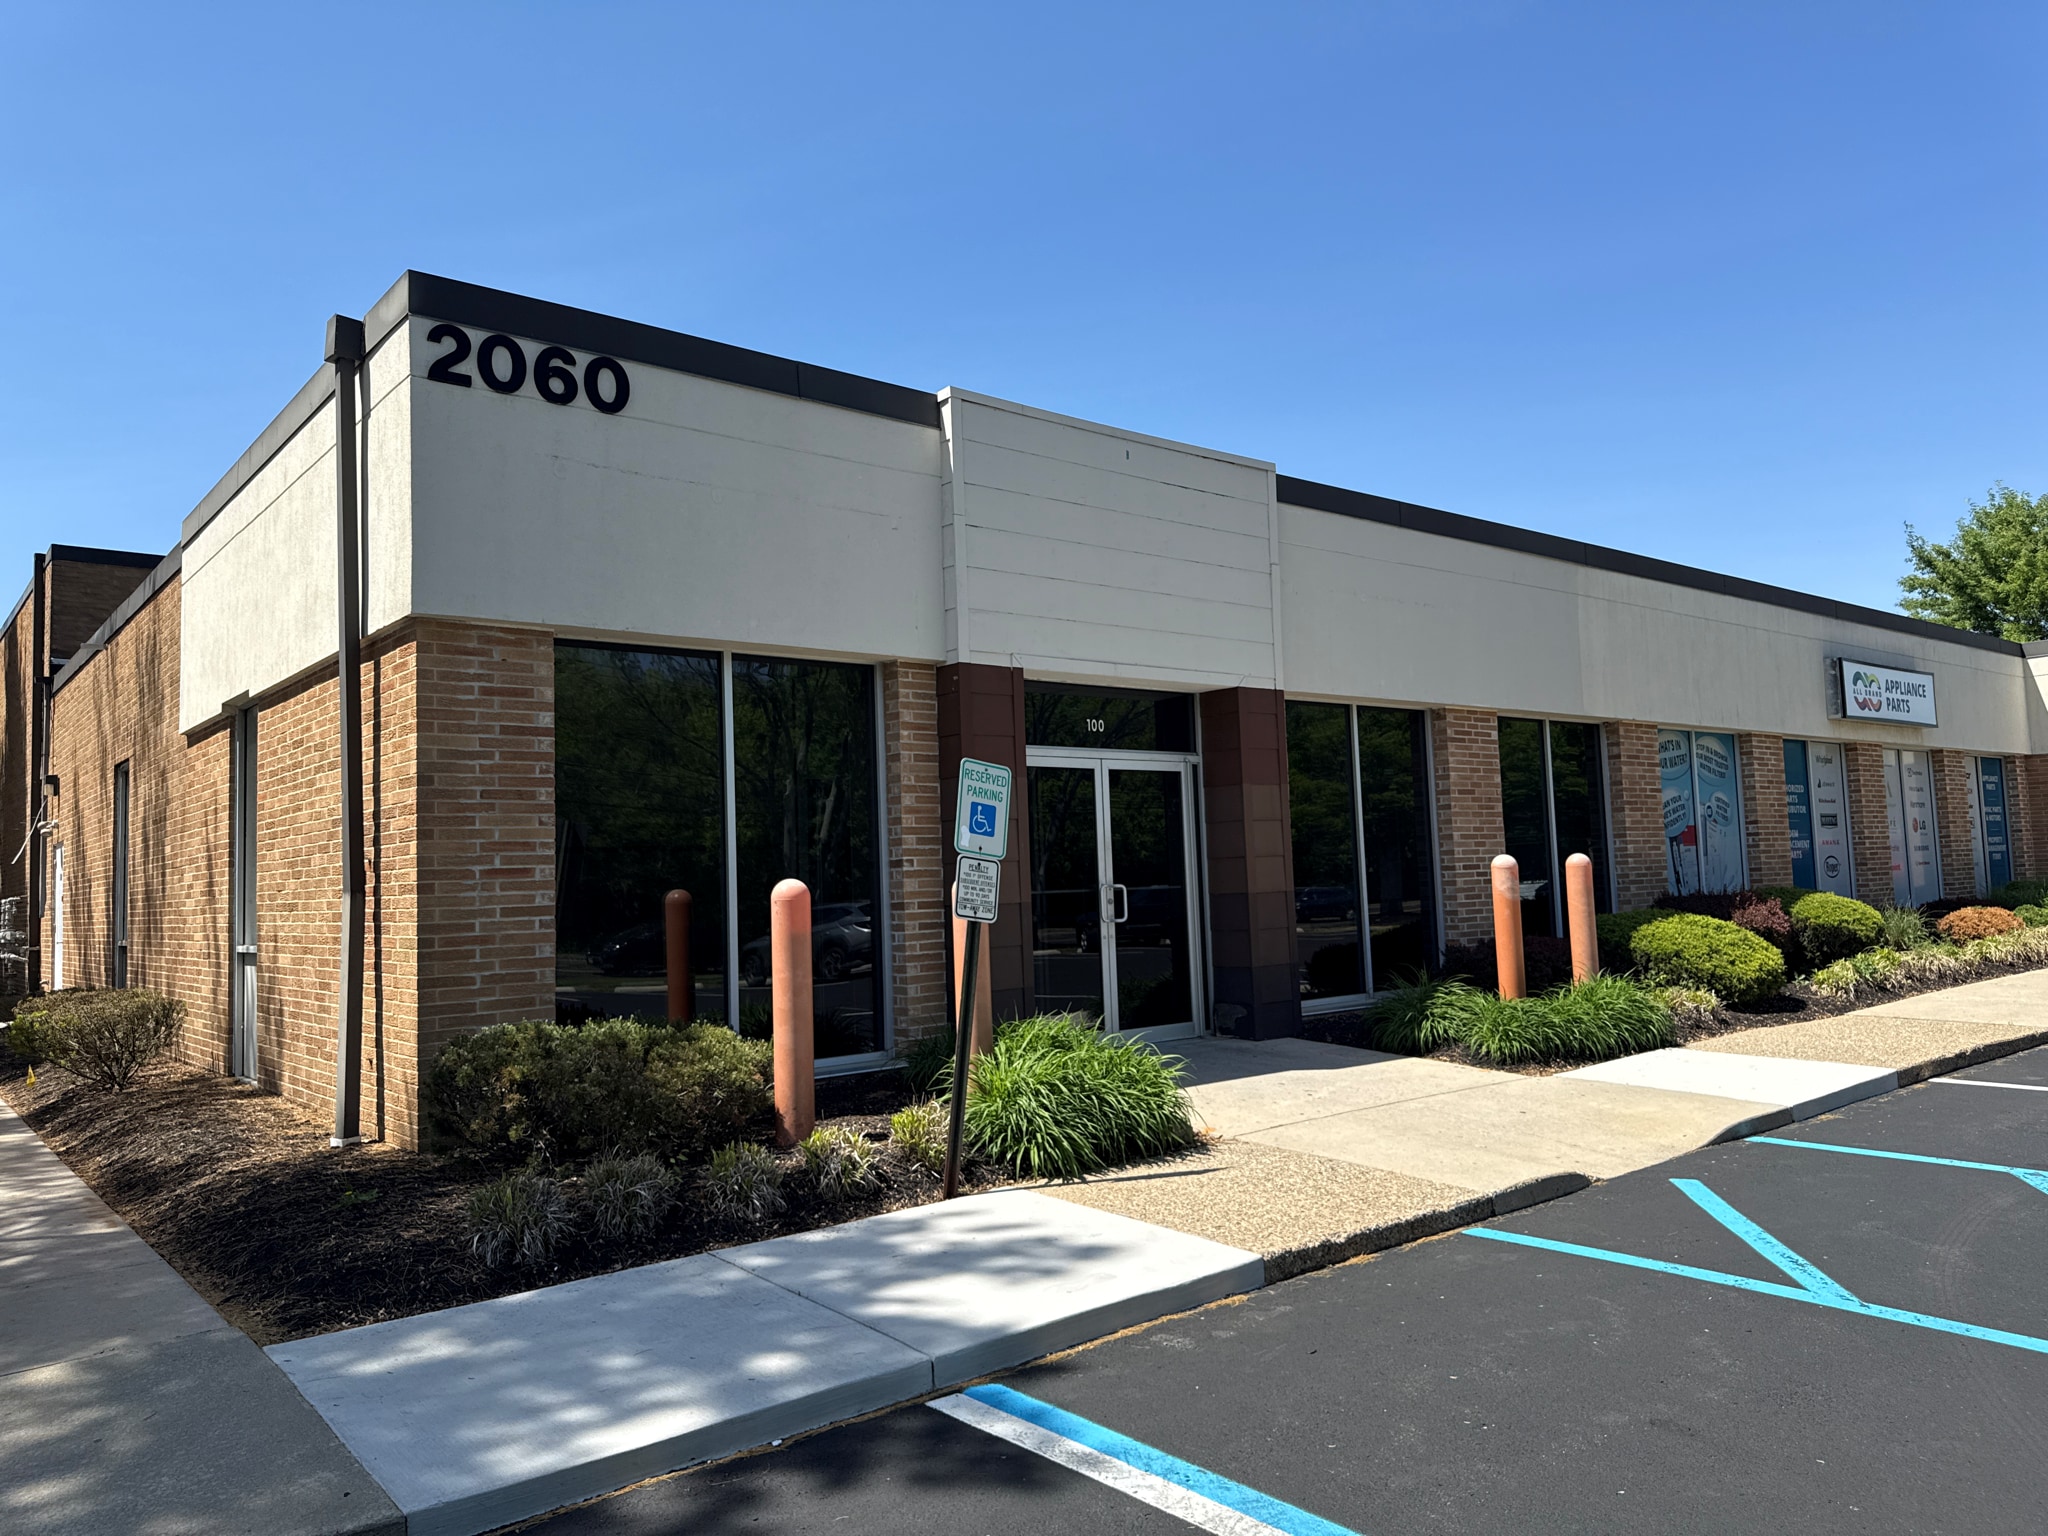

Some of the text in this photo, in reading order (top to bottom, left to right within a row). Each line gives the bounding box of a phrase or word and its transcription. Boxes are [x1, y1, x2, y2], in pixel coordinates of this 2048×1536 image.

[427, 323, 630, 415] 2060
[1865, 689, 1882, 698] BRAND
[1885, 679, 1927, 698] APPLIANCE
[1886, 697, 1911, 714] PARTS
[1086, 718, 1105, 733] 100
[1675, 739, 1682, 751] IN
[965, 768, 1007, 788] RESERVED
[966, 784, 1003, 803] PARKING
[1787, 785, 1804, 793] ORIZED
[1919, 820, 1927, 830] LG
[968, 864, 989, 873] PENALTY
[959, 903, 994, 914] TOW-AWAY ZONE
